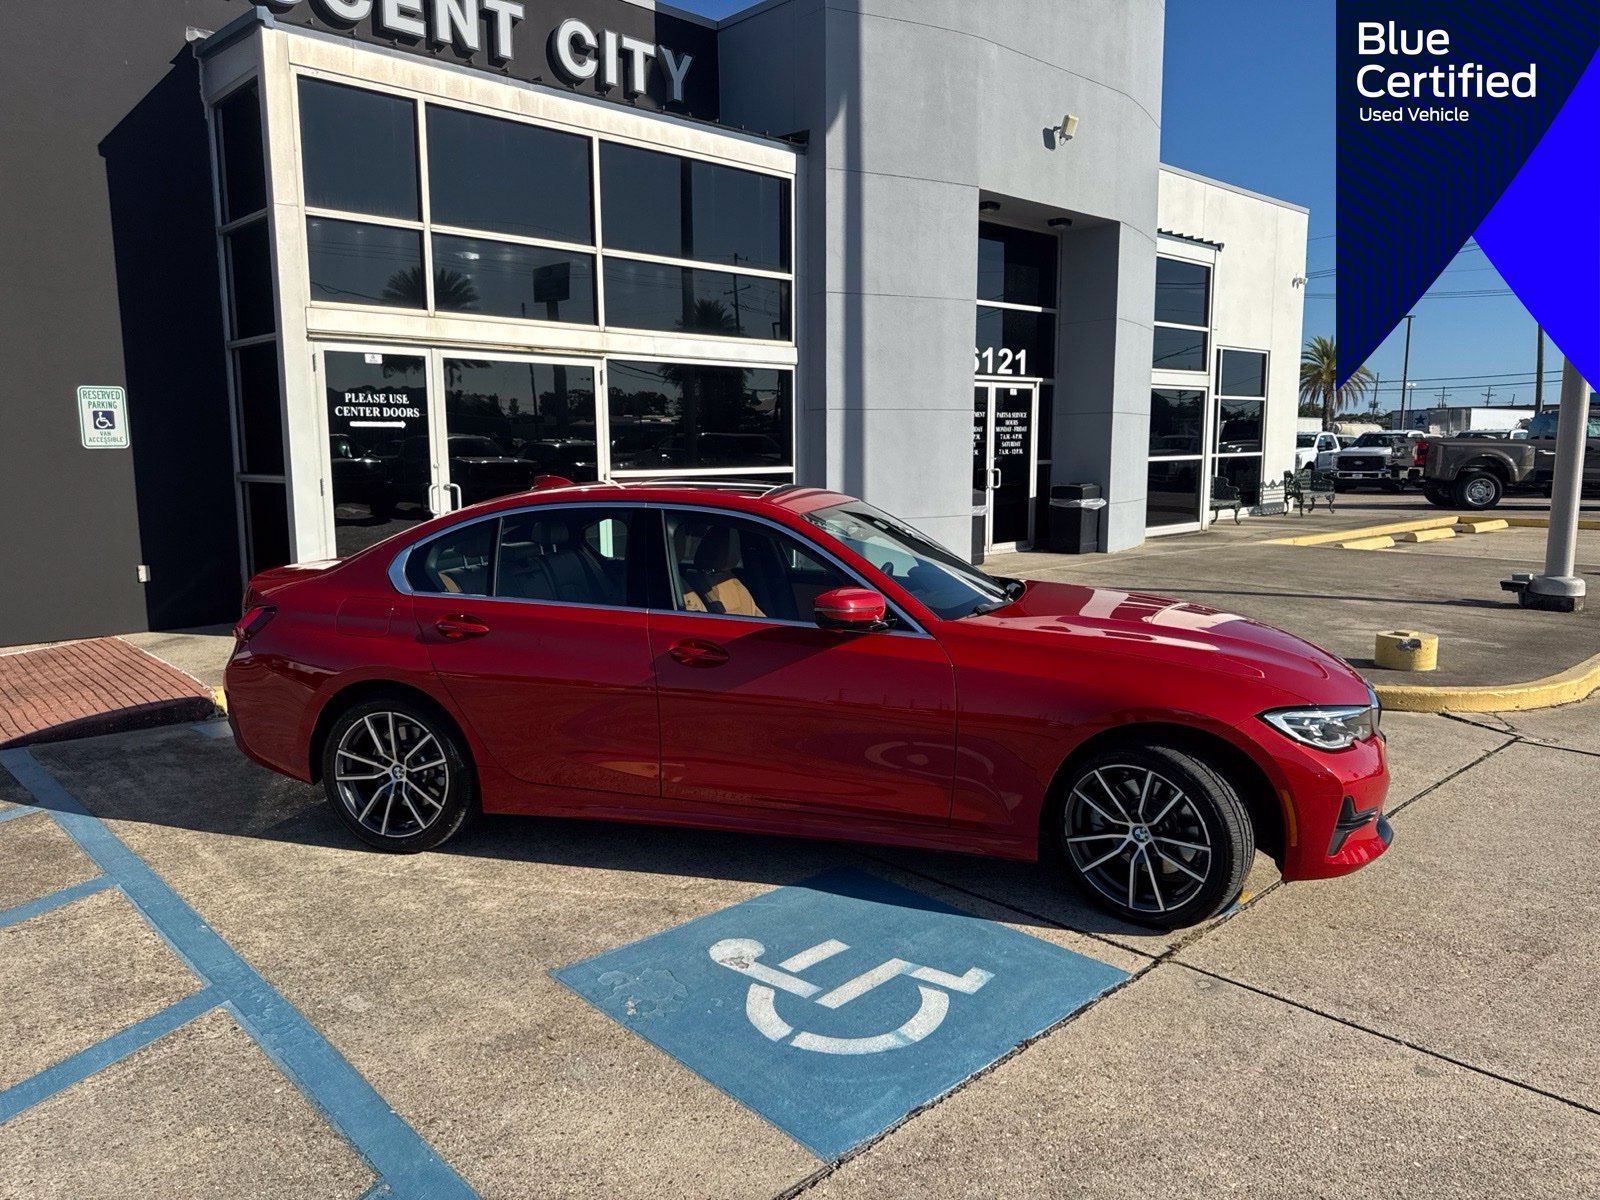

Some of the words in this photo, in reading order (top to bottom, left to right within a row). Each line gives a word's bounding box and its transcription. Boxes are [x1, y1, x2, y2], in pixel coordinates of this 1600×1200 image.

[555, 17, 694, 101] CITY
[82, 390, 121, 400] RESERVED
[344, 392, 387, 404] PLEASE
[389, 393, 410, 404] USE
[87, 401, 118, 409] PARKING
[334, 405, 381, 417] CENTER
[383, 407, 420, 418] DOORS
